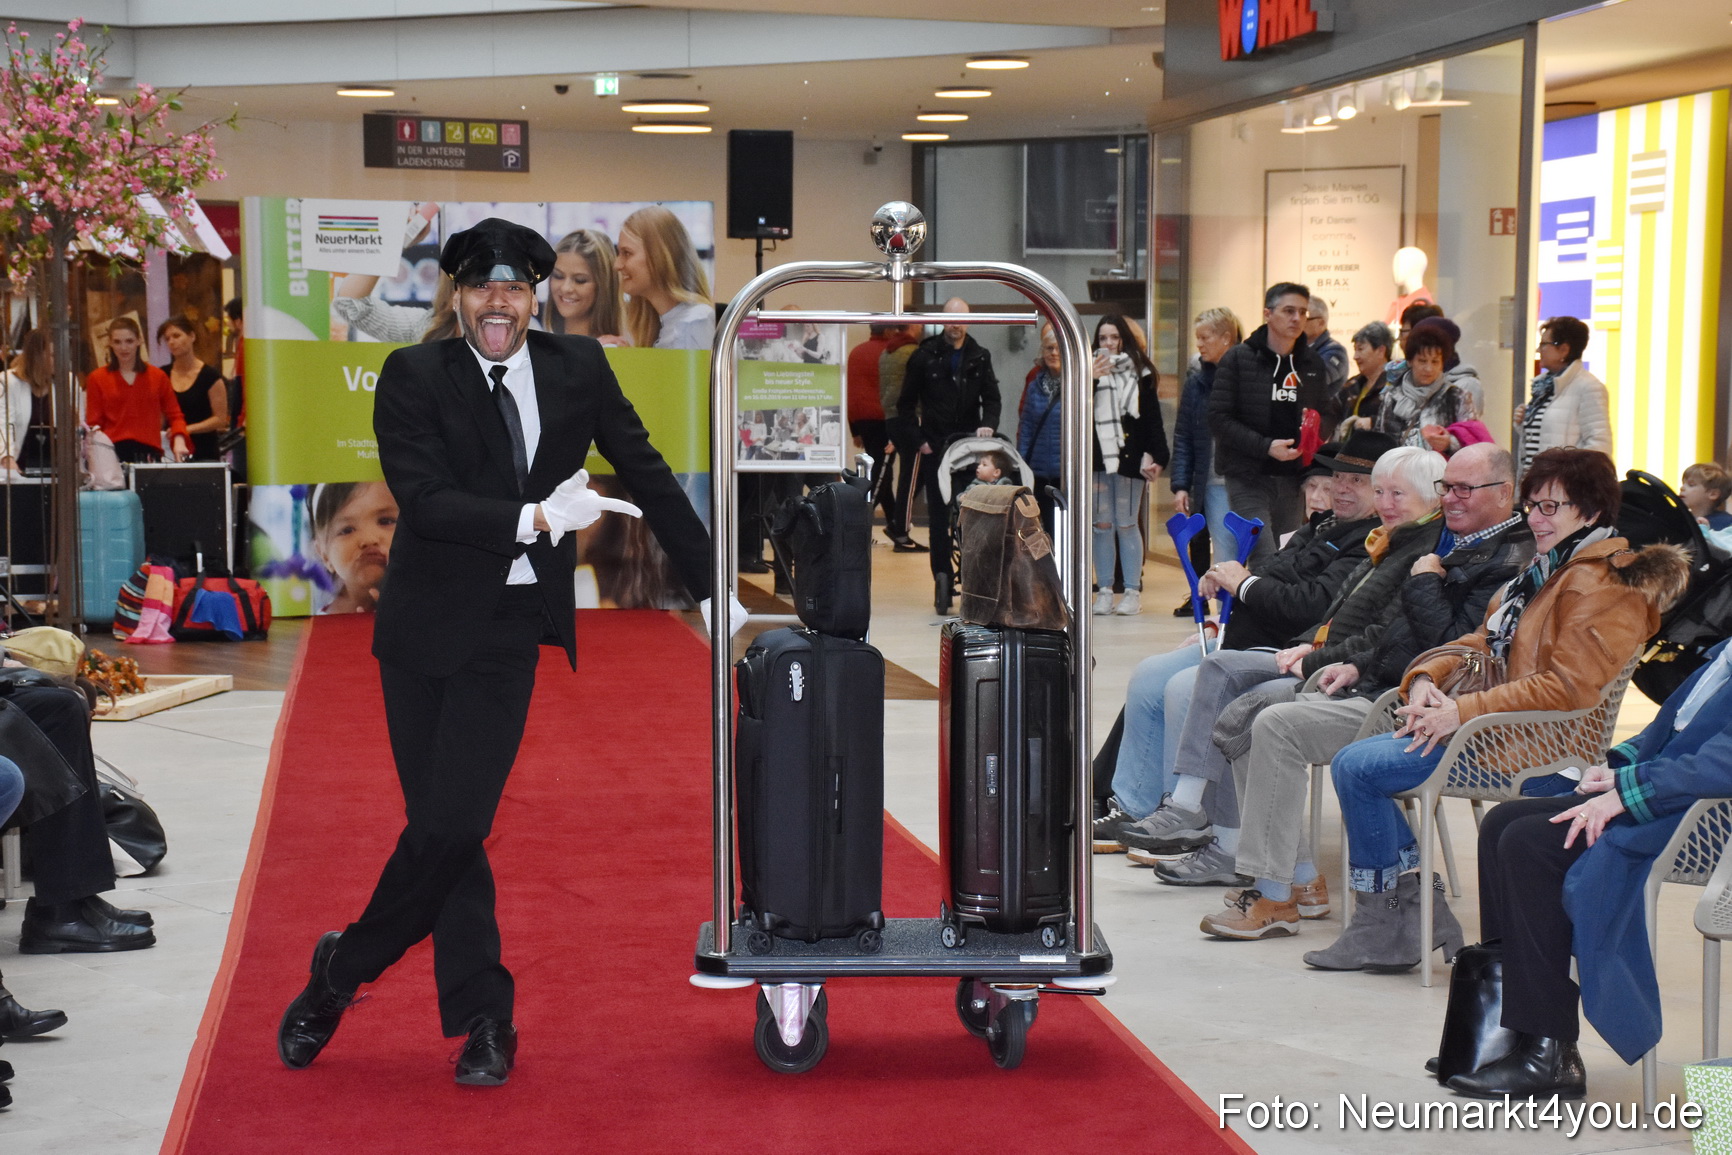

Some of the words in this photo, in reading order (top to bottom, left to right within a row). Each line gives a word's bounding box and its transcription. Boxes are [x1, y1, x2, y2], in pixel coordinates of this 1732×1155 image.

[397, 146, 406, 154] IN
[407, 146, 423, 155] DER
[426, 146, 466, 157] UNTEREN
[397, 157, 466, 168] LADENSTRASSE
[1302, 184, 1329, 193] Diese
[1332, 183, 1368, 192] Marken
[1290, 195, 1319, 205] finden
[1323, 195, 1337, 205] Sie
[1340, 195, 1353, 204] im
[1310, 216, 1323, 225] Für
[315, 233, 383, 246] NeuerMarkt
[1307, 264, 1332, 273] GERRY
[1334, 263, 1360, 272] WEBER
[1317, 279, 1349, 287] BRAX
[342, 366, 380, 392] Vo
[763, 370, 775, 378] Von
[776, 370, 814, 379] Lieblingsteil
[337, 439, 347, 447] Im
